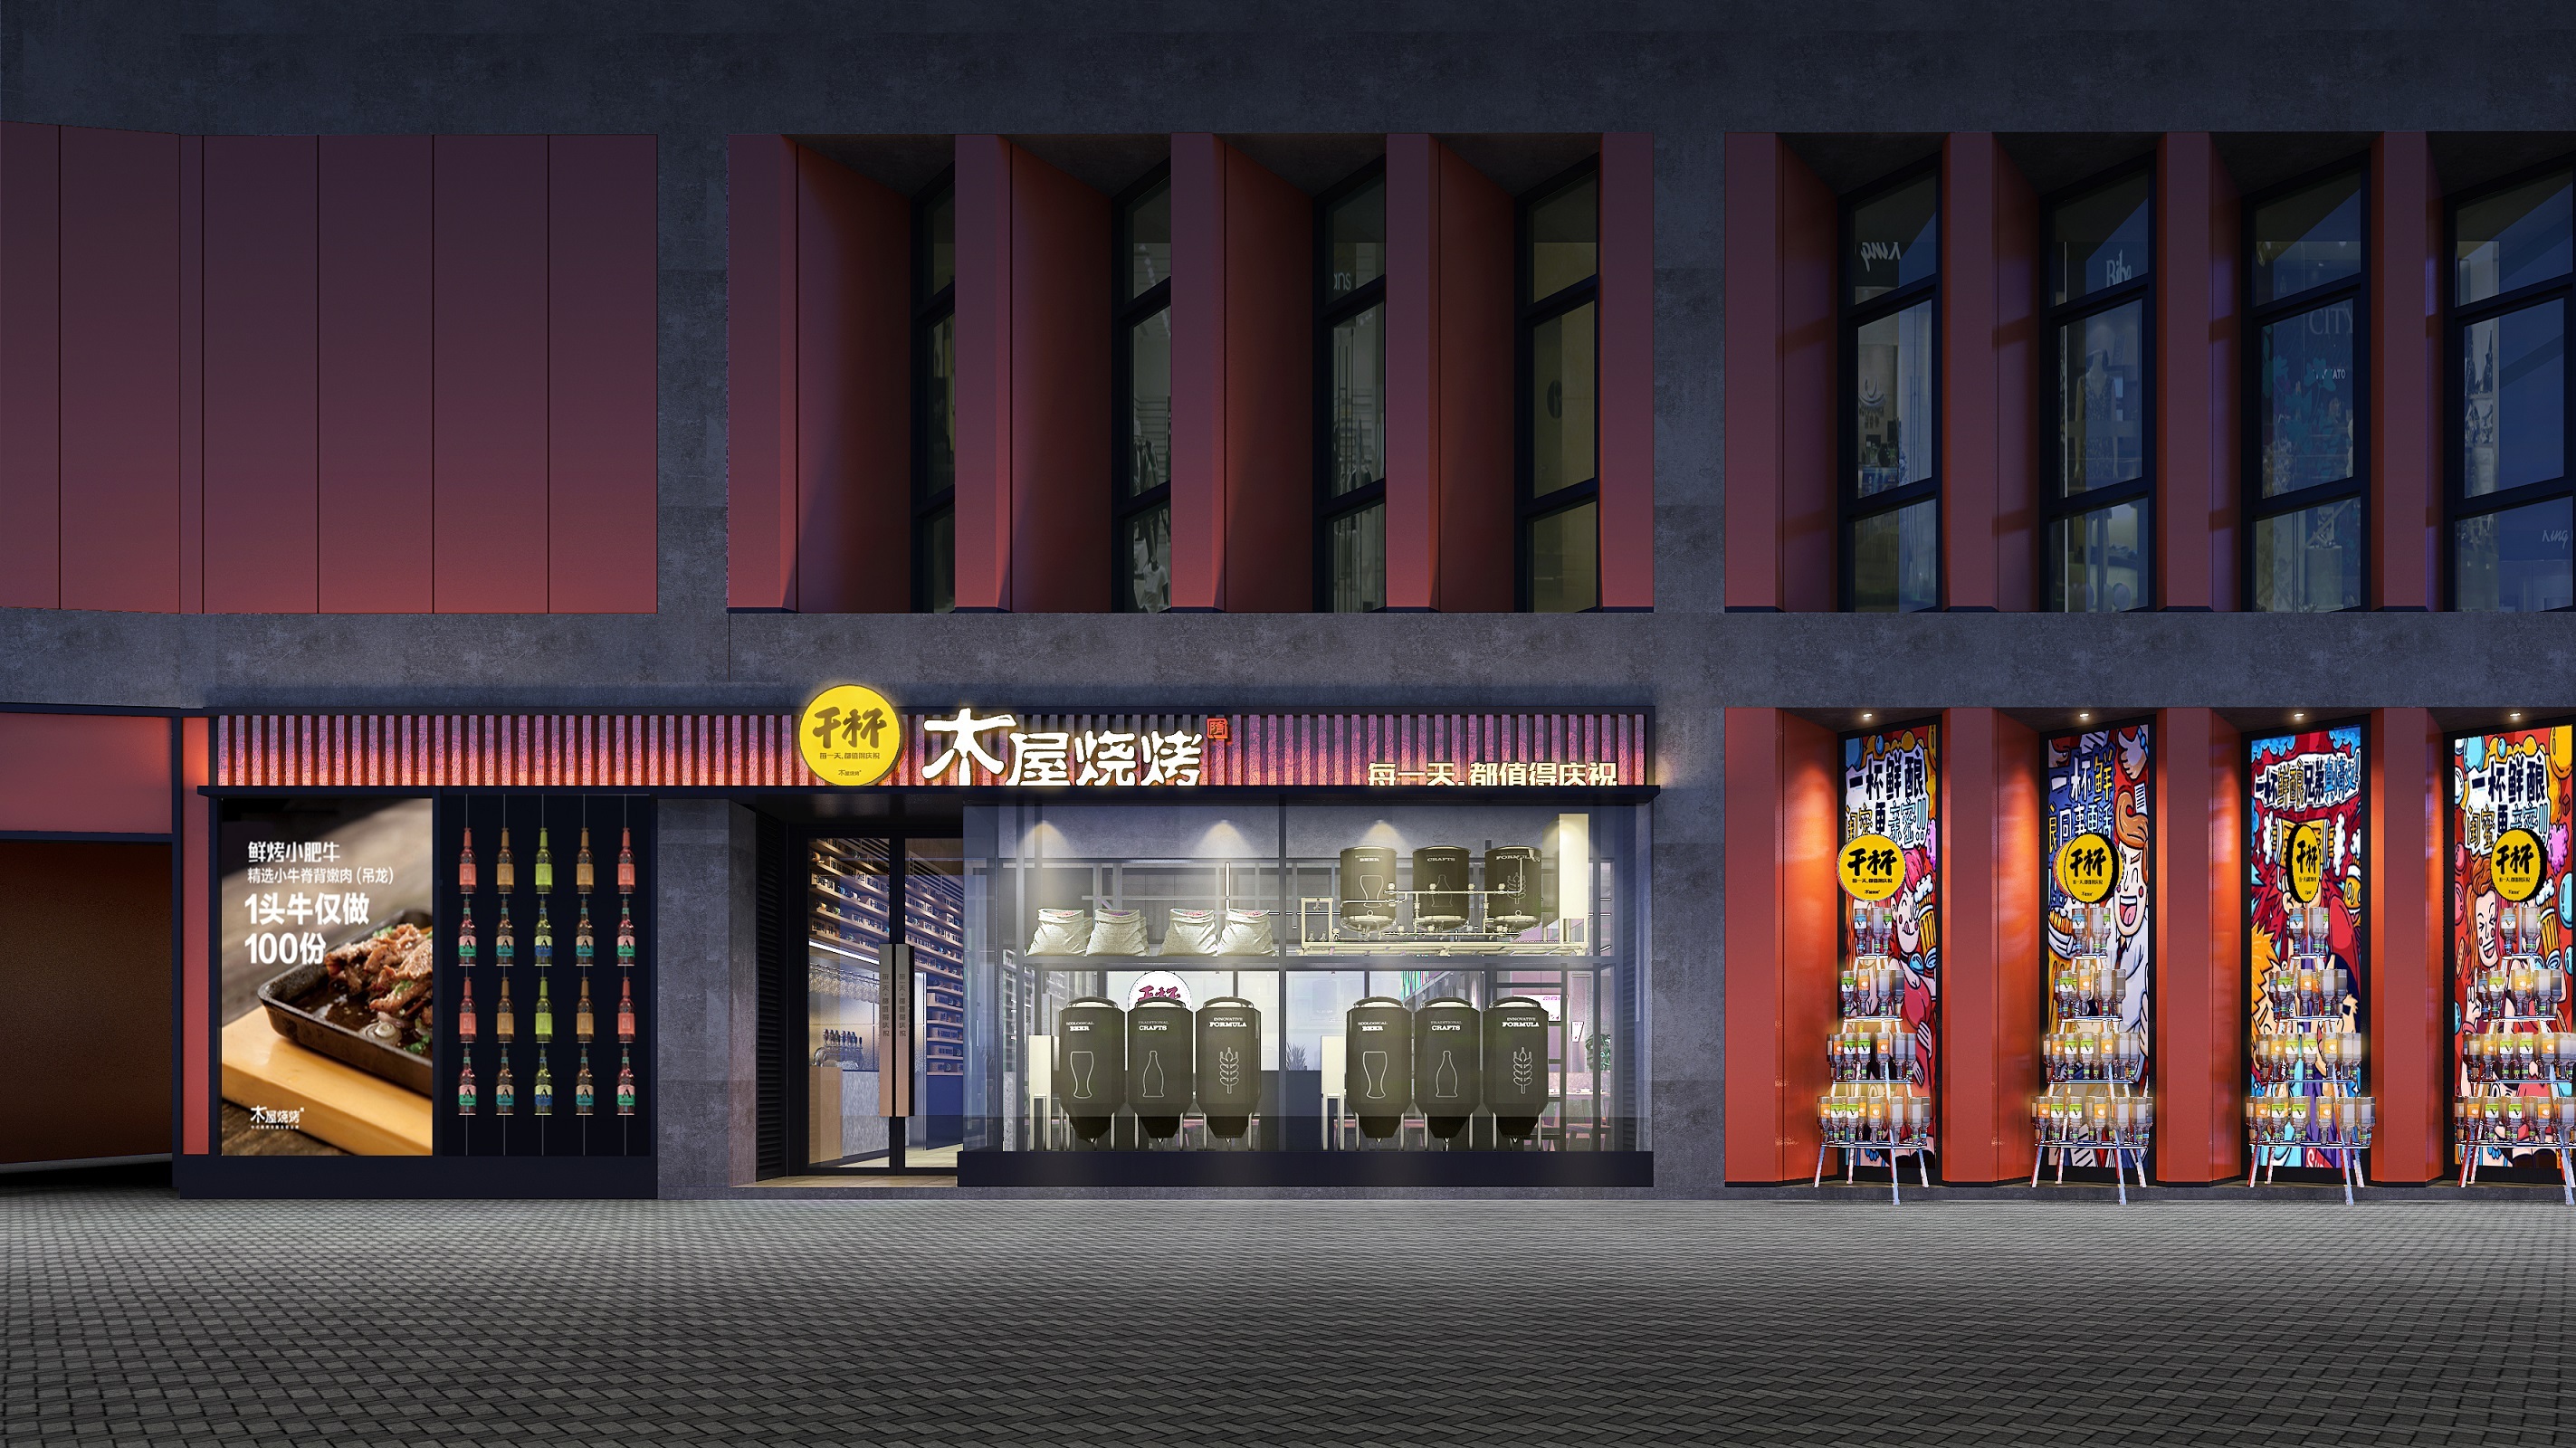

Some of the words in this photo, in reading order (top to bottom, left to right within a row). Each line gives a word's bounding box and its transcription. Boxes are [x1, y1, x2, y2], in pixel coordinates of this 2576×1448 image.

[922, 708, 1203, 786] 木屋烧烤
[1849, 749, 1924, 800] 一杯鲜酿
[2051, 749, 2113, 802] 一杯鲜
[2472, 755, 2545, 803] 一杯鲜酿
[248, 842, 340, 862] 鲜烤小肥牛
[1847, 848, 1897, 876] 干杯
[2070, 847, 2106, 877] 干杯
[2495, 843, 2534, 875] 干杯
[244, 892, 369, 925] 1头牛仅做
[244, 932, 326, 965] 100份
[250, 1105, 300, 1123] 木屋烧烤
